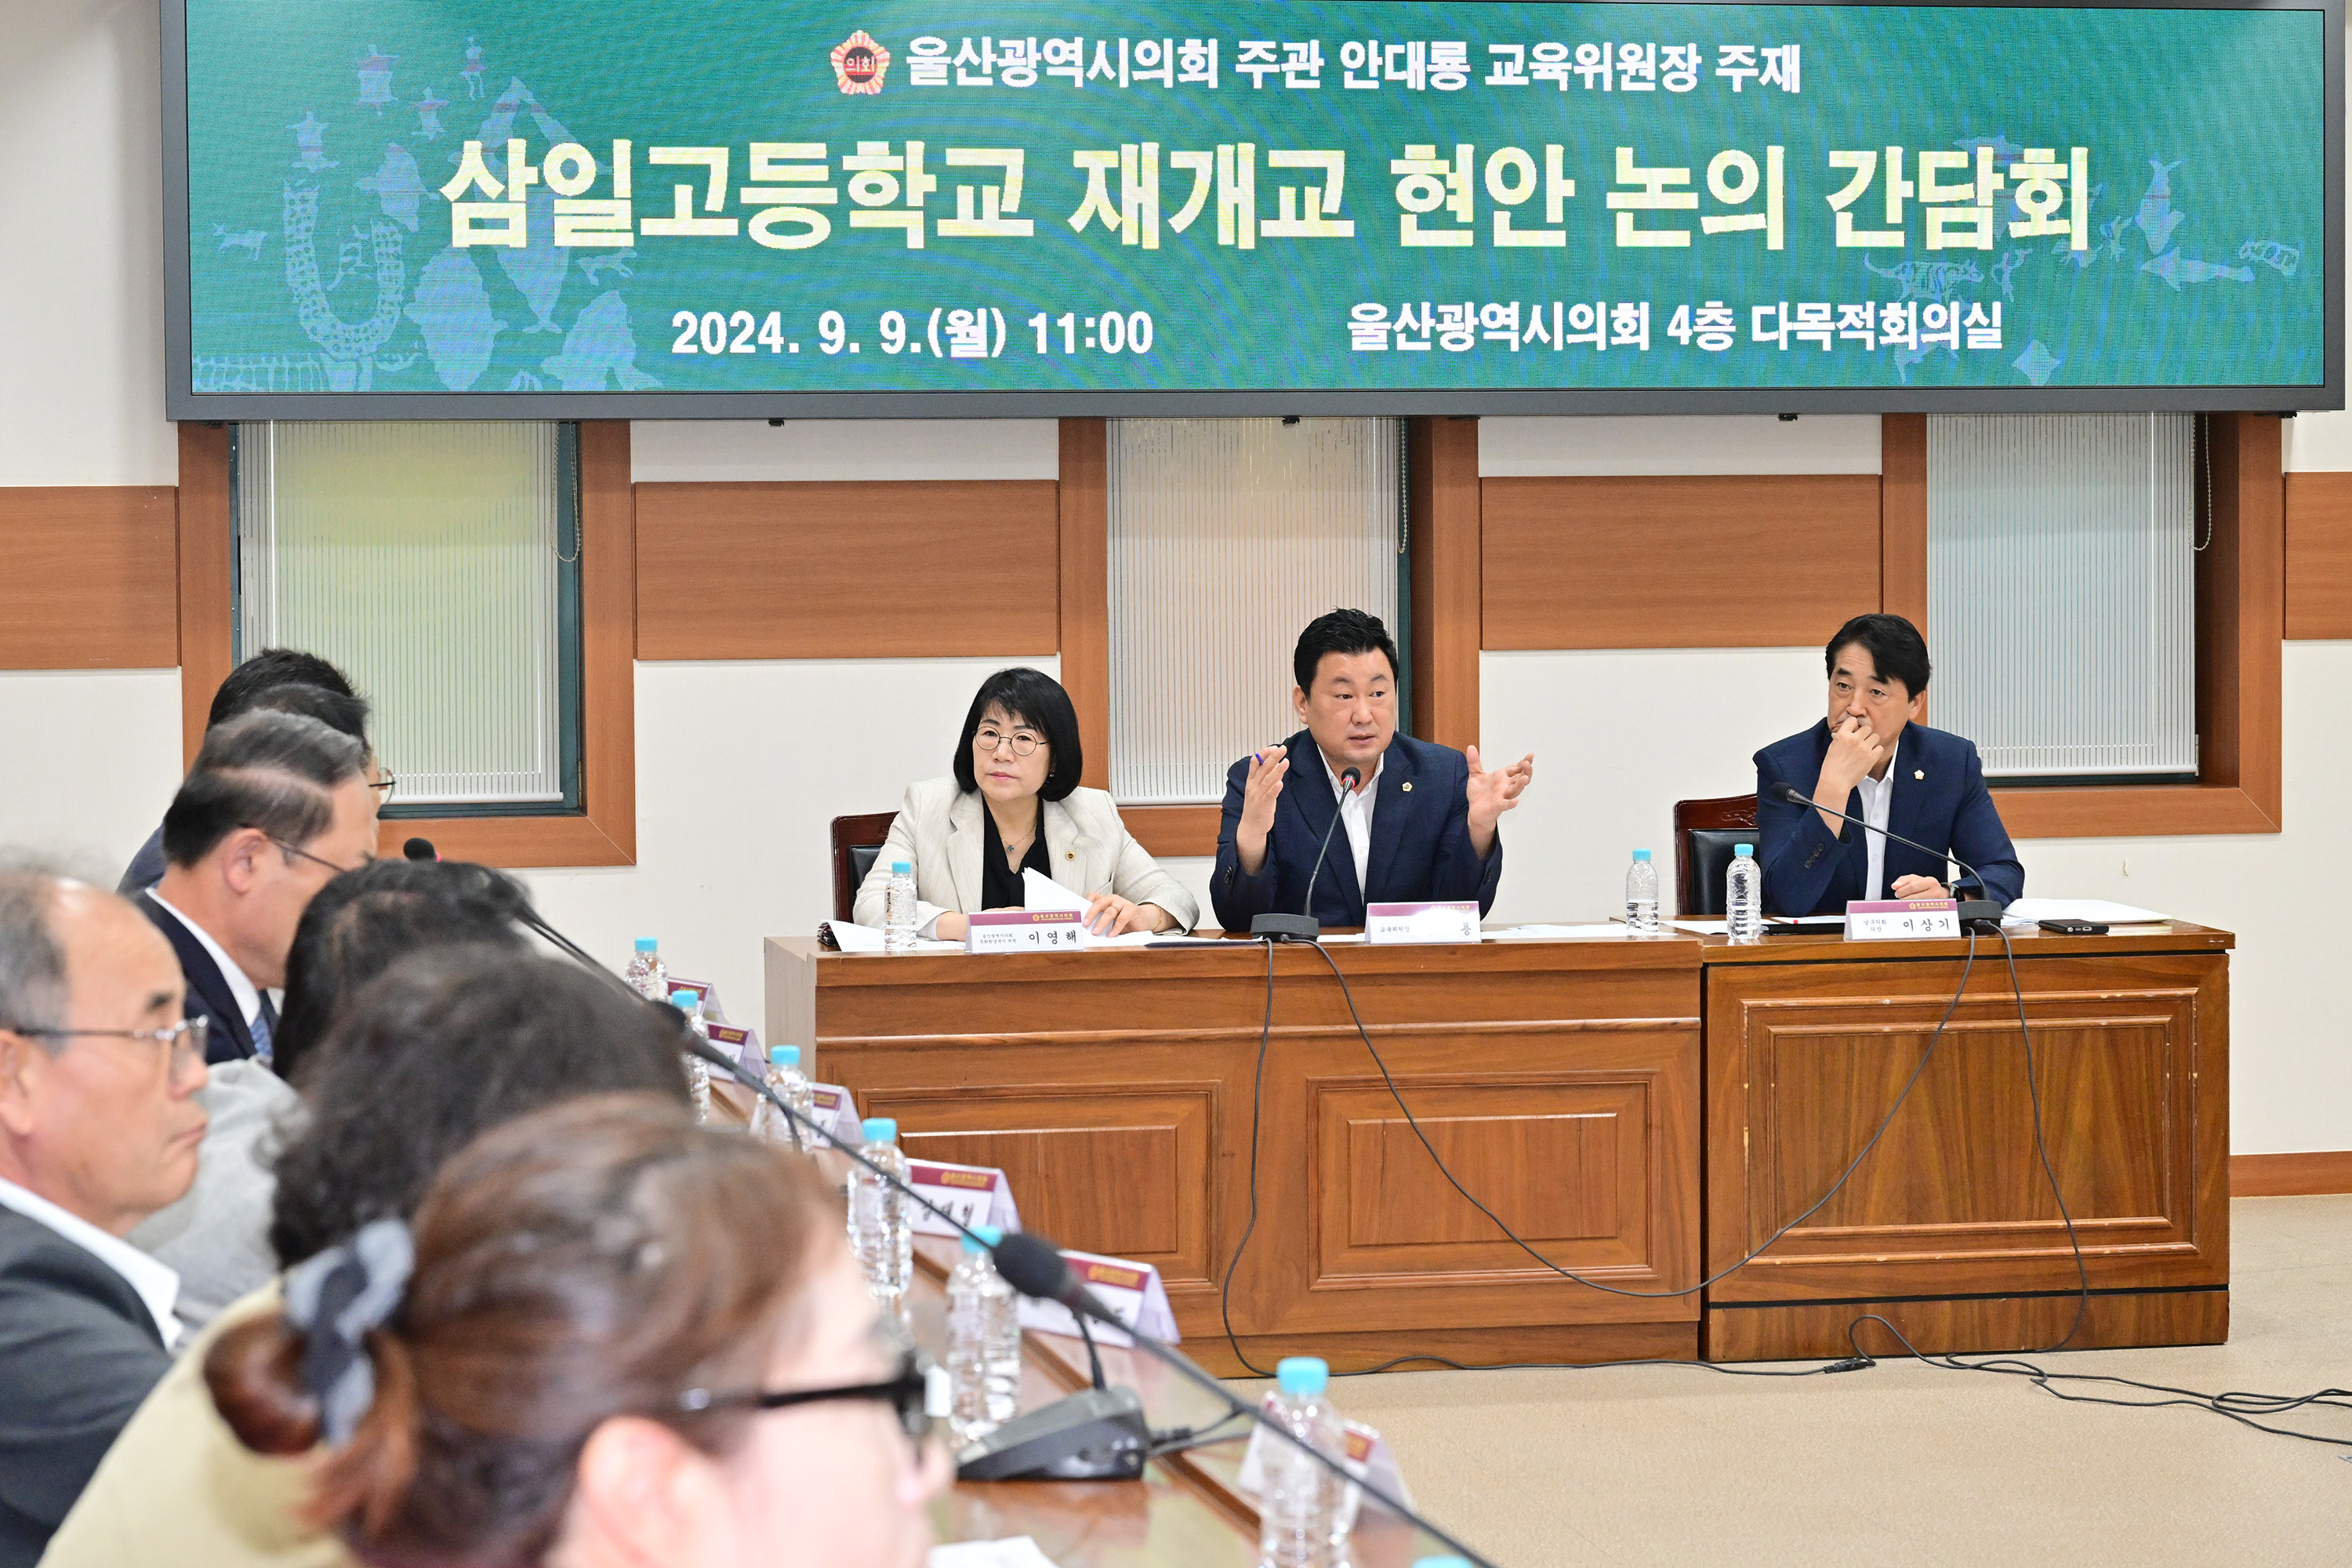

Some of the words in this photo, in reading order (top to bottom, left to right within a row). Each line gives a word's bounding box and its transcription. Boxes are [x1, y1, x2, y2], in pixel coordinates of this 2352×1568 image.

[845, 56, 875, 74] 의회
[906, 36, 1218, 89] 울산광역시의회
[1236, 39, 1324, 89] 주관
[1340, 39, 1471, 91] 안대룡
[1485, 42, 1702, 93] 교육위원장
[1715, 44, 1800, 93] 주재
[440, 138, 1034, 249] 삼일고등학교
[1068, 142, 1355, 249] 재개교
[1390, 143, 1575, 247] 현안
[1606, 145, 1784, 250] 논의
[1826, 146, 2089, 251] 간담회
[672, 310, 800, 354] 2024.
[818, 310, 860, 354] 9.
[880, 307, 1006, 358] 9.(월)
[1028, 311, 1153, 354] 11:00
[1347, 301, 1650, 352] 울산광역시의회
[1667, 301, 1736, 351] 4층
[1751, 301, 2002, 351] 다목적회의실
[1029, 930, 1076, 945] 이영해
[1903, 917, 1950, 932] 이상기
